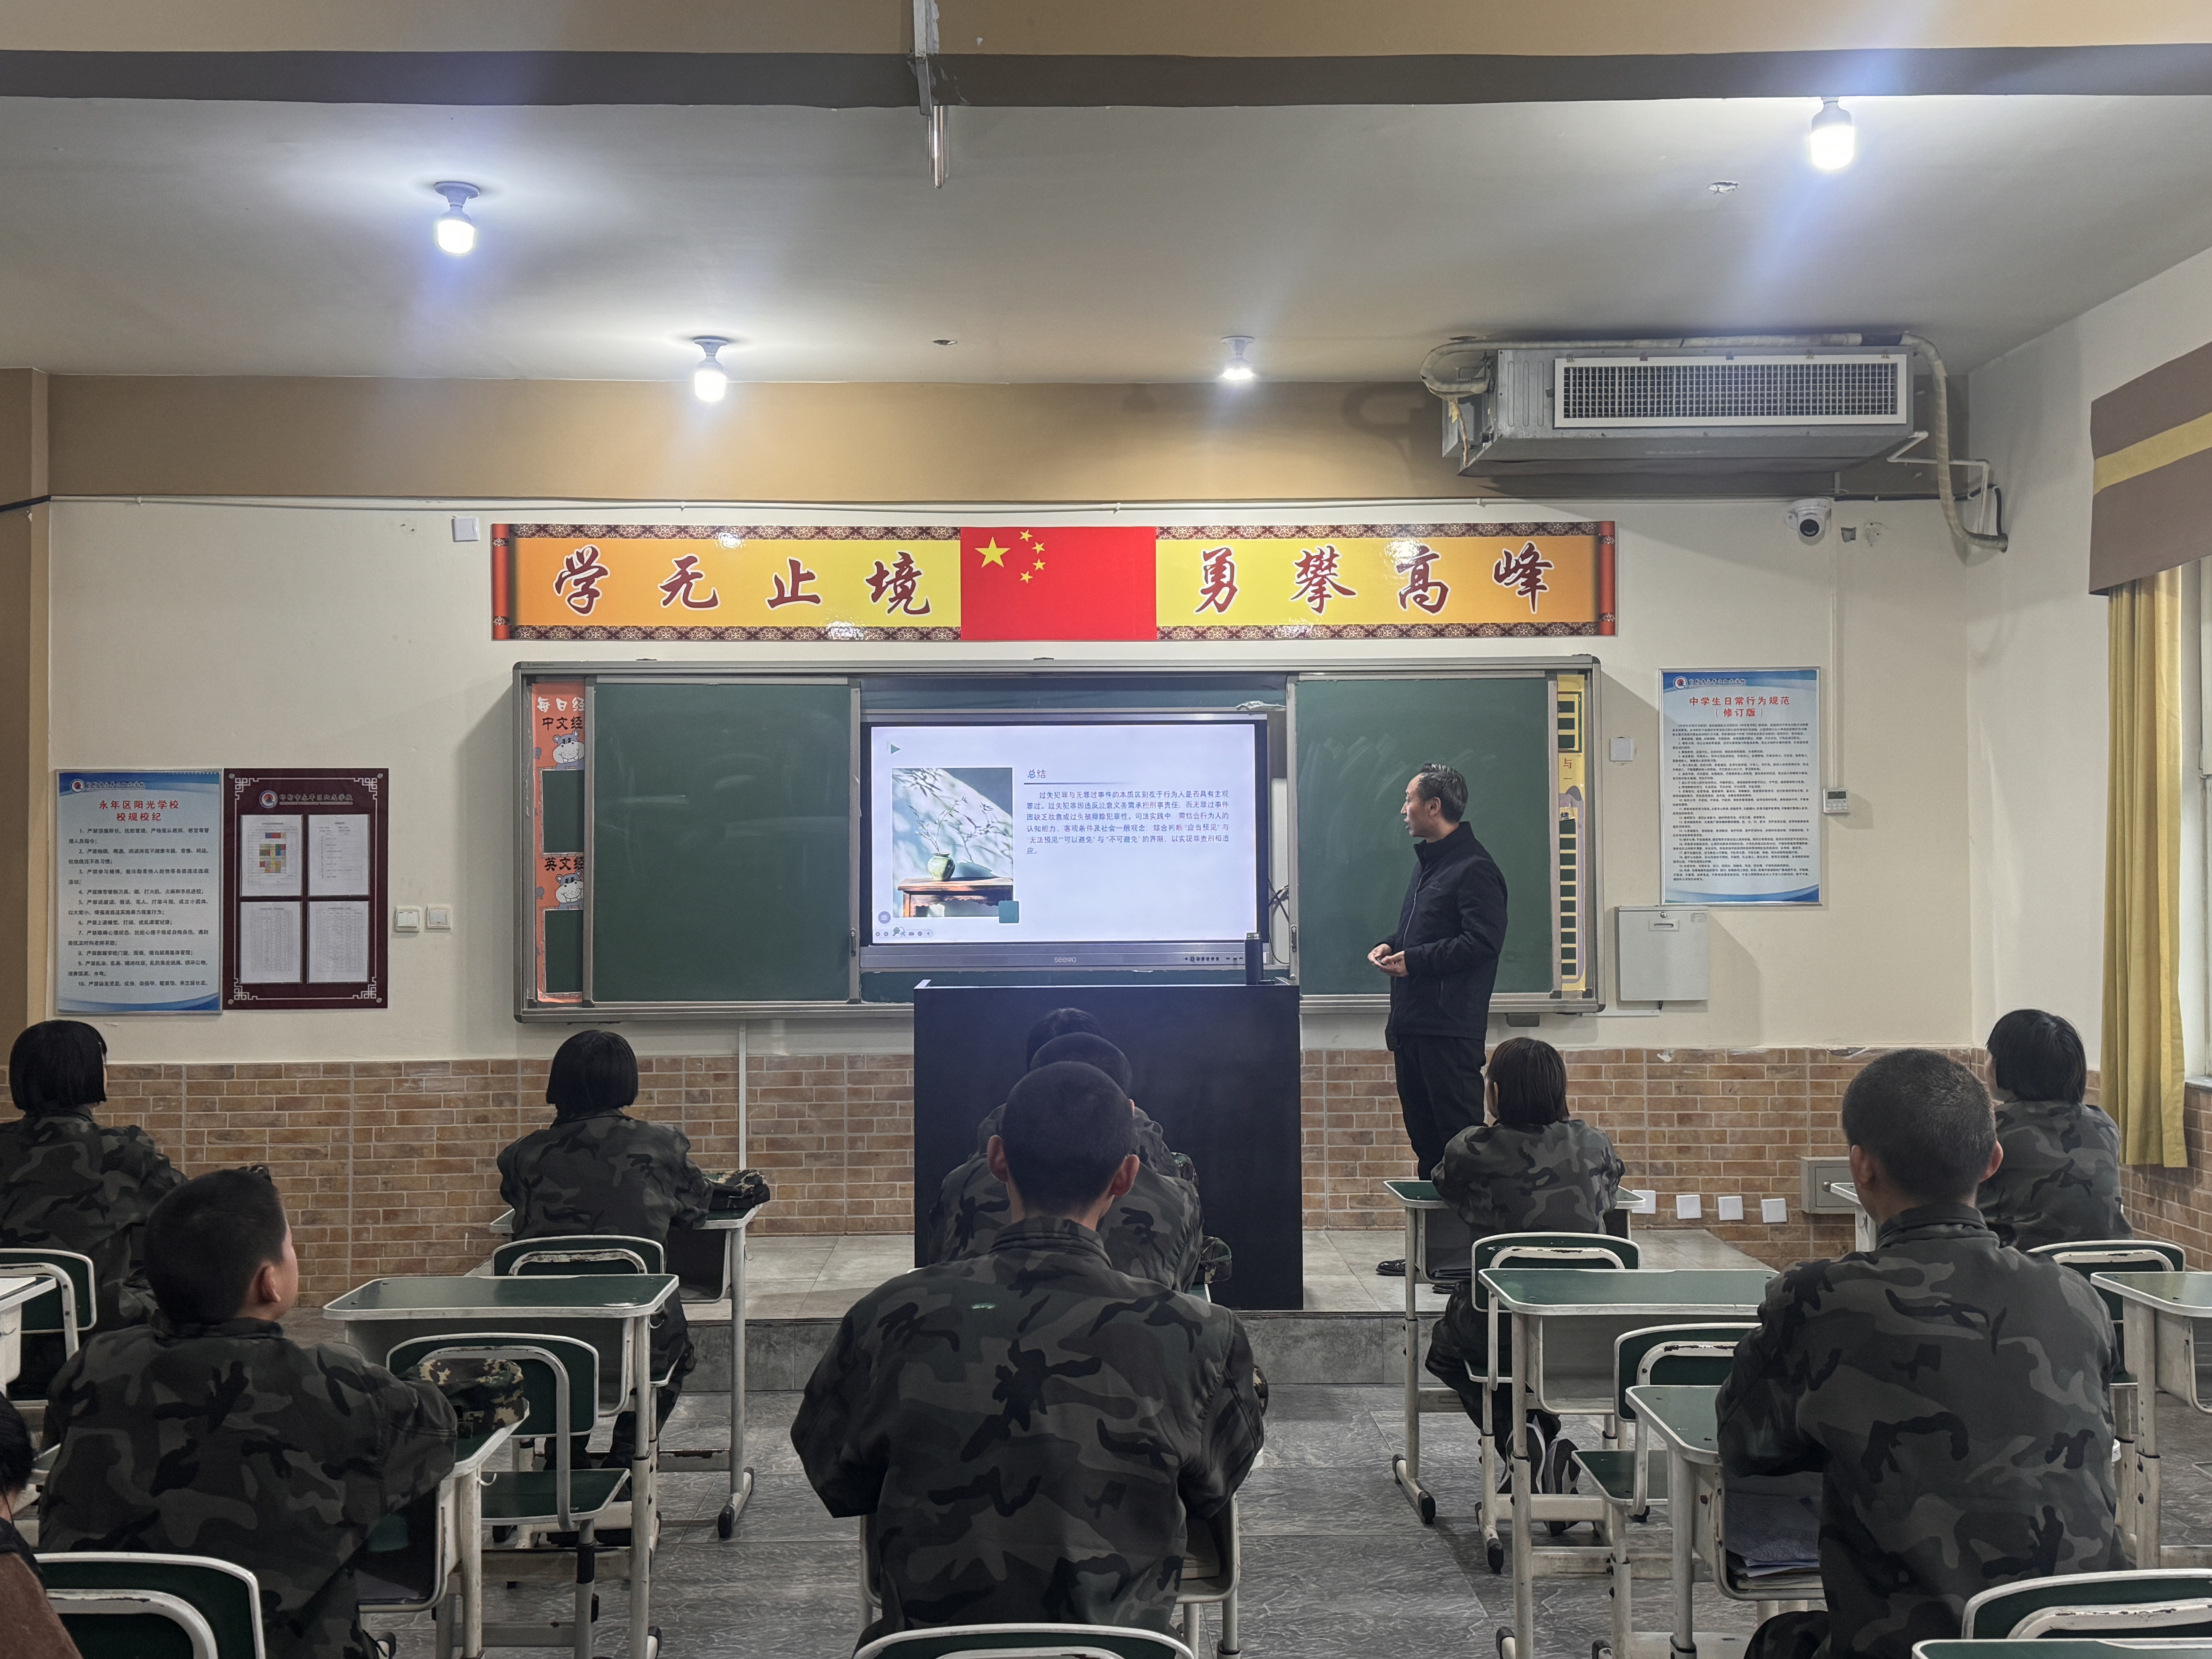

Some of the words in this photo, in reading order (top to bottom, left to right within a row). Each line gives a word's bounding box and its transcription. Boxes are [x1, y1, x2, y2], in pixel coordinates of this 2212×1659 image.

[553, 544, 931, 615] 学无止境
[1194, 541, 1554, 616] 勇攀高峰
[1689, 696, 1790, 706] 中学生日常行为规范
[1027, 769, 1046, 778] 总结
[99, 800, 179, 809] 永年区阳光学校
[117, 812, 161, 821] 校规校纪
